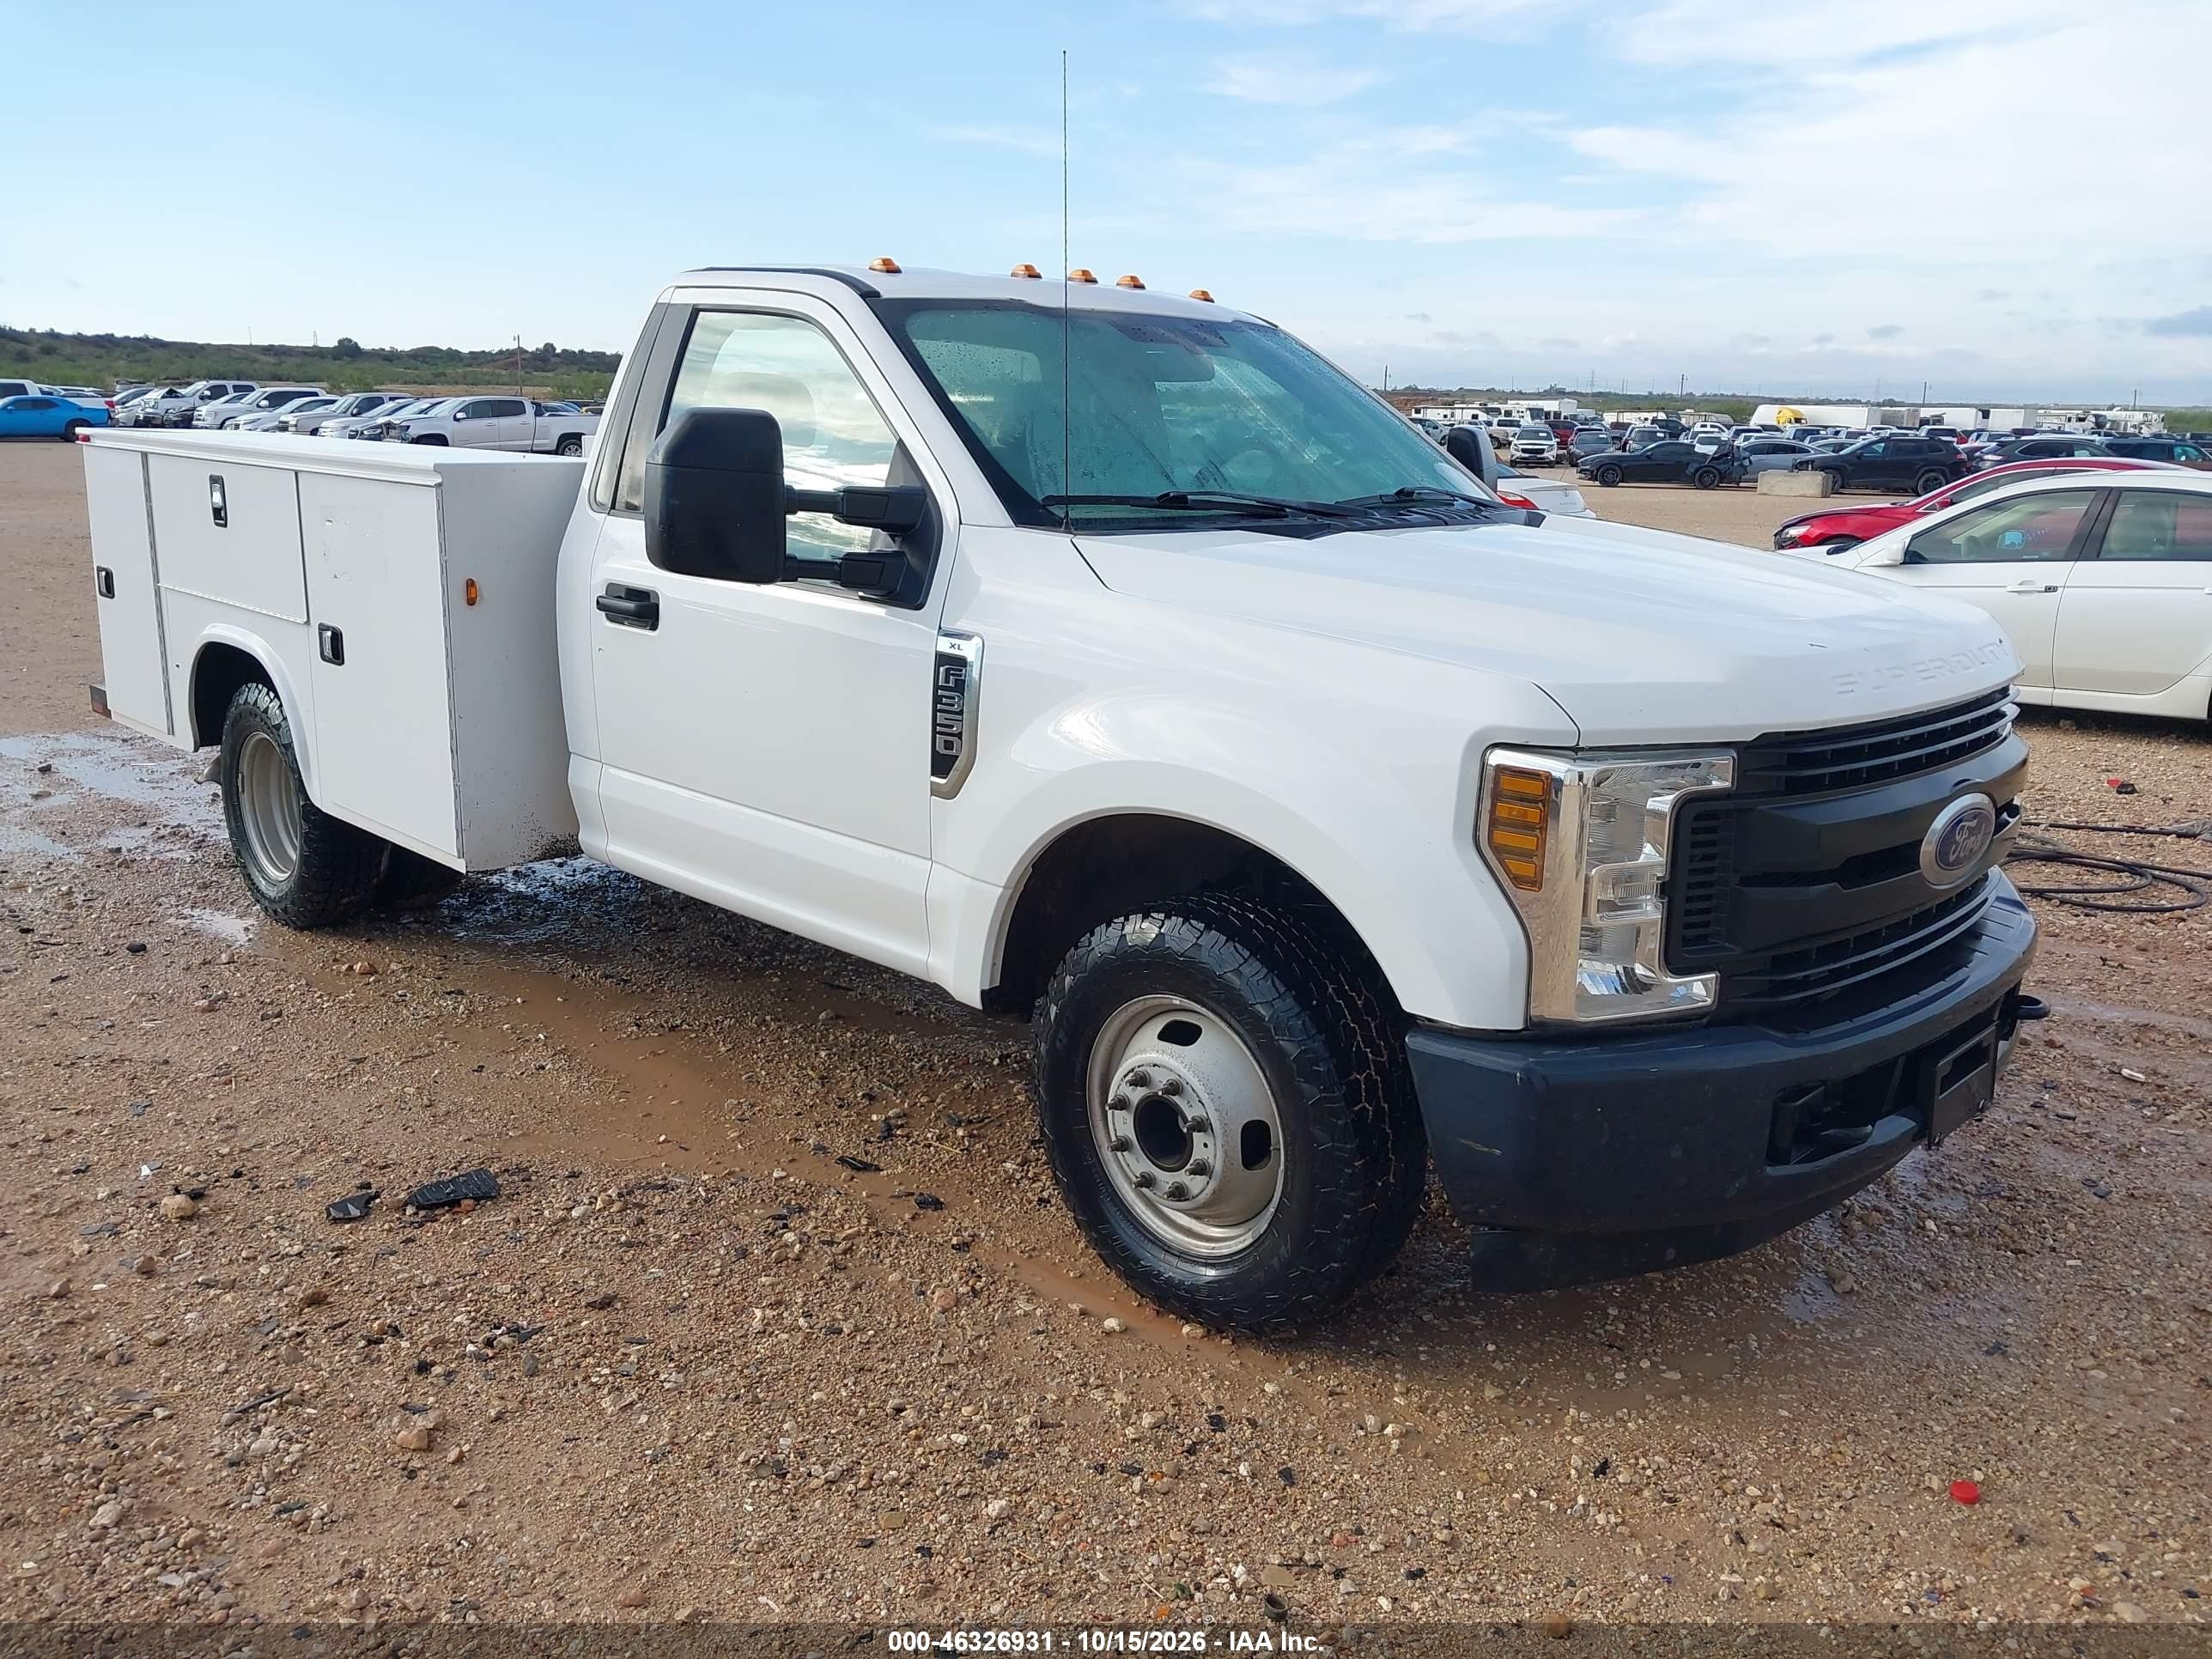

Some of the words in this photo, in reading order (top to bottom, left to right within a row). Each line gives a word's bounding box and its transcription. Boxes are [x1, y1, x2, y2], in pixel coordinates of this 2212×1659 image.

[948, 641, 963, 651] XL
[936, 665, 966, 756] F350
[1949, 818, 1985, 862] Ford
